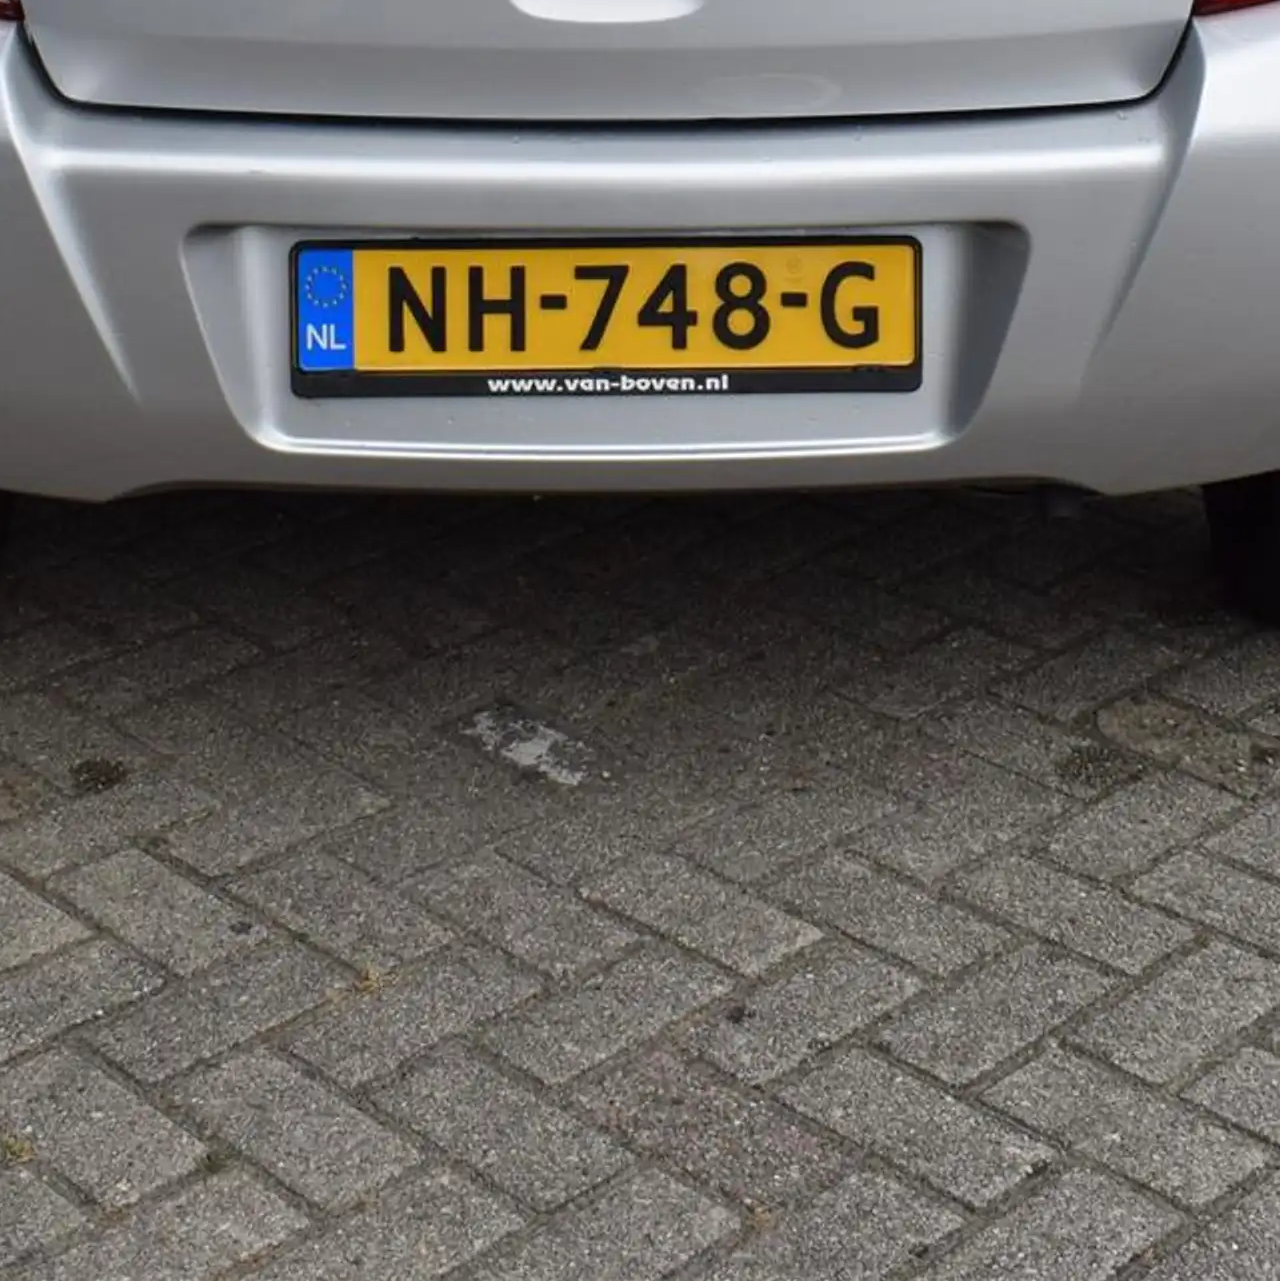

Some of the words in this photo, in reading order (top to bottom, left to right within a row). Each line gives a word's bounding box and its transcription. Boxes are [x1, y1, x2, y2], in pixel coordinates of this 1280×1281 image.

[387, 260, 880, 353] NH-748-G
[306, 324, 346, 350] NL
[487, 373, 731, 393] www.van-boven.nl
